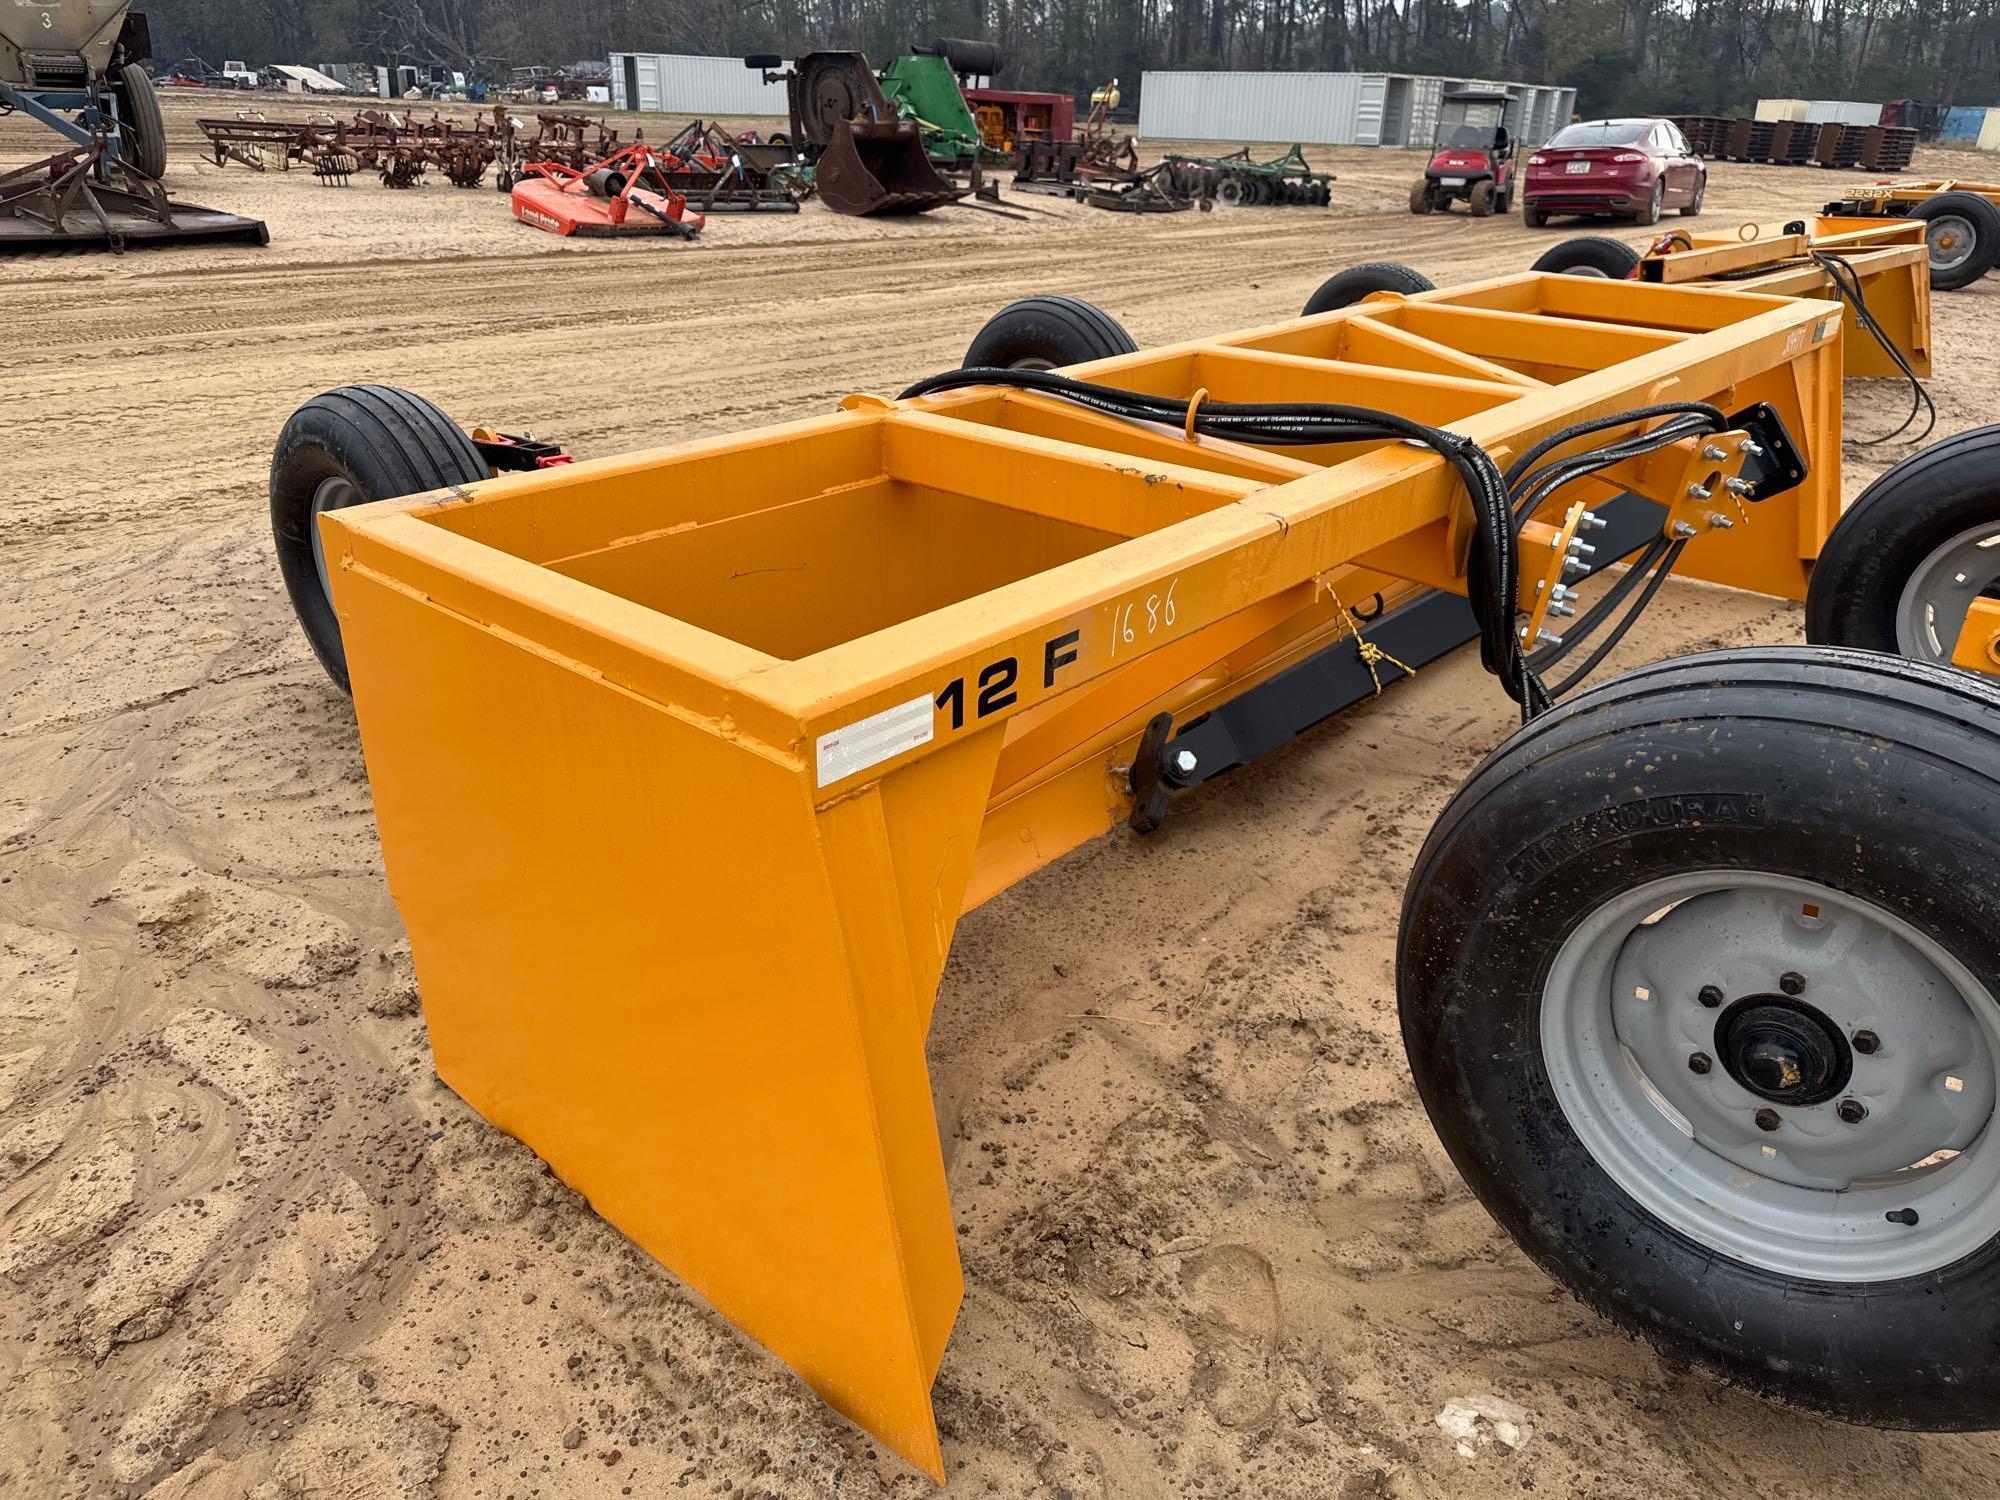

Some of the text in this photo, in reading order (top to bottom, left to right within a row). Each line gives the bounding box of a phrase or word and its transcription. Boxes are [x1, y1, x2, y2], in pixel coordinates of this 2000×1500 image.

[41, 12, 52, 29] 3
[521, 205, 560, 227] Land Pride
[1110, 578, 1178, 658] 1686
[935, 629, 1081, 730] 12 F
